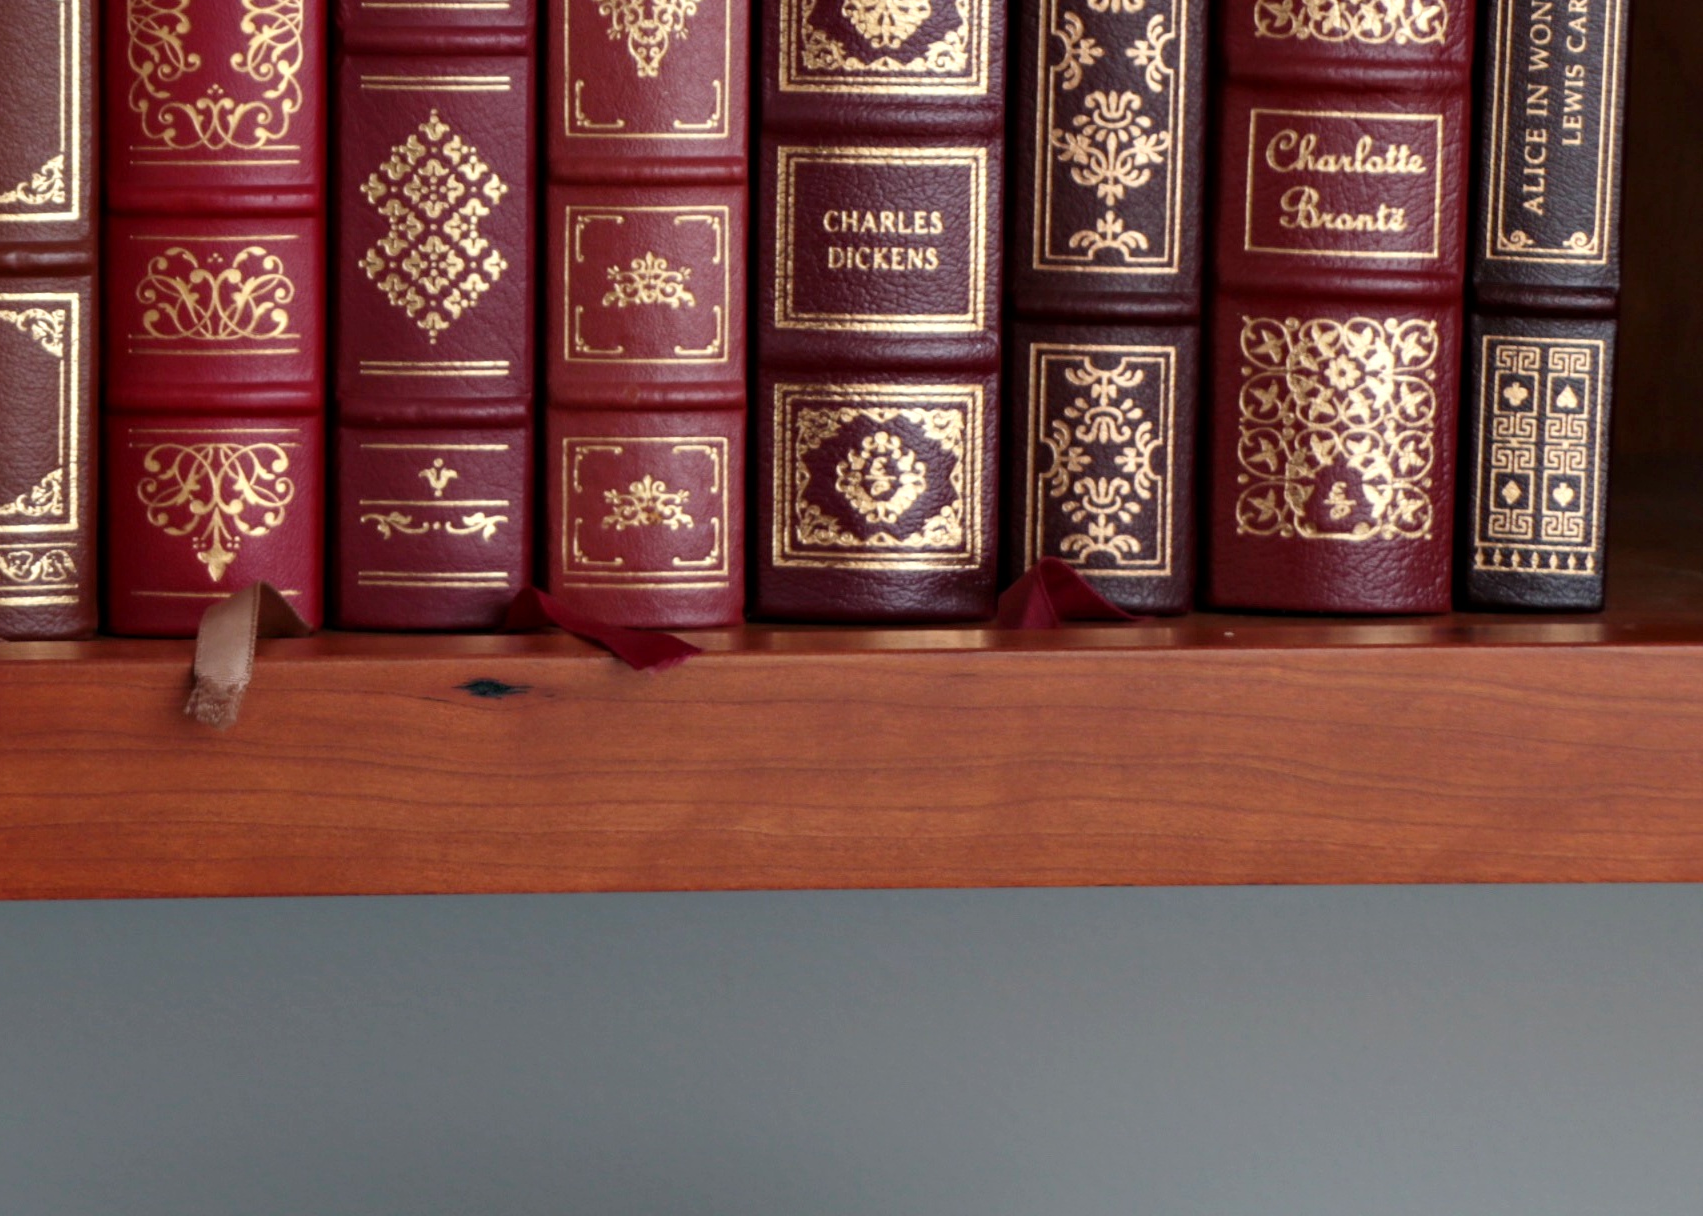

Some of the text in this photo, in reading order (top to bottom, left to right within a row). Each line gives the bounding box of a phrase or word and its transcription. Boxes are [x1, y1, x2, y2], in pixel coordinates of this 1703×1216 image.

[1526, 84, 1550, 118] IN
[1561, 65, 1584, 146] LEWIS
[1265, 128, 1428, 175] Charlotte
[1522, 126, 1549, 217] ALICE
[823, 210, 943, 234] CHARLES
[1280, 186, 1407, 232] Brontë
[828, 246, 940, 271] DICKENS
